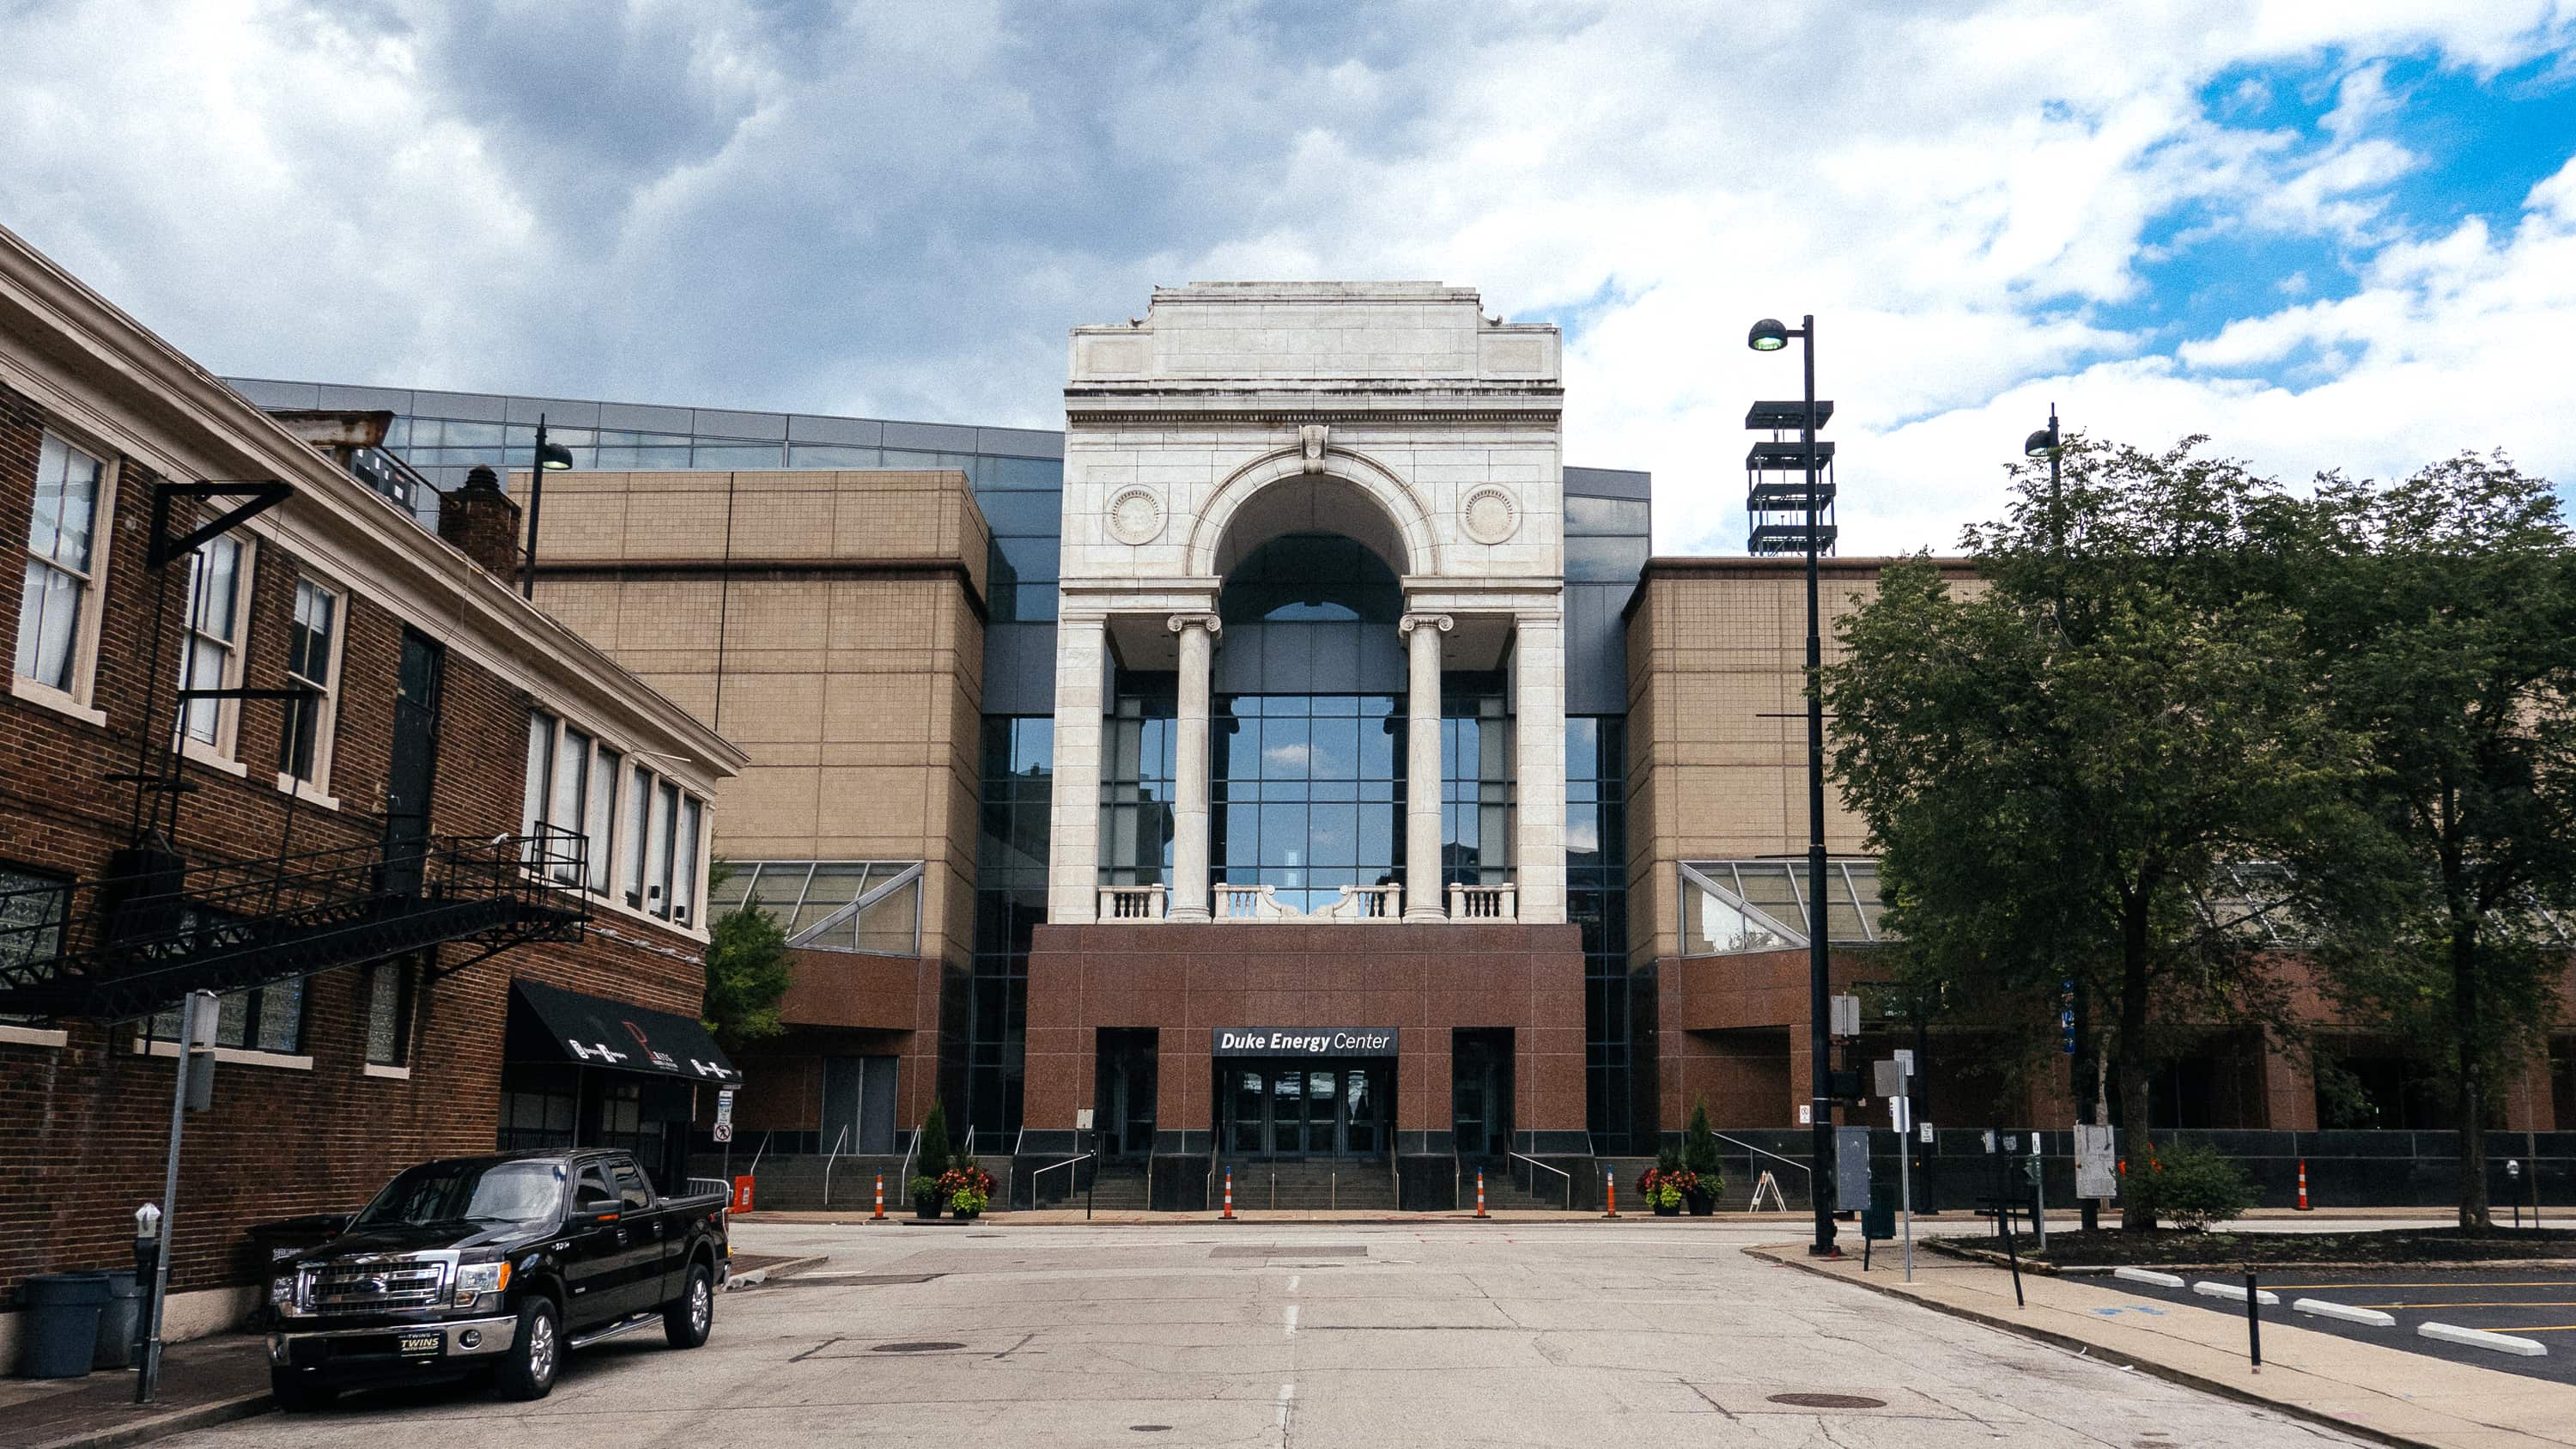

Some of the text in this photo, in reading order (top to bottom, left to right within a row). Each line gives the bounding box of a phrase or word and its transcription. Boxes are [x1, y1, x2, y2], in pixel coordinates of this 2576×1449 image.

[1221, 1032, 1389, 1052] Duke Energy Center
[401, 1337, 440, 1348] TWINS
